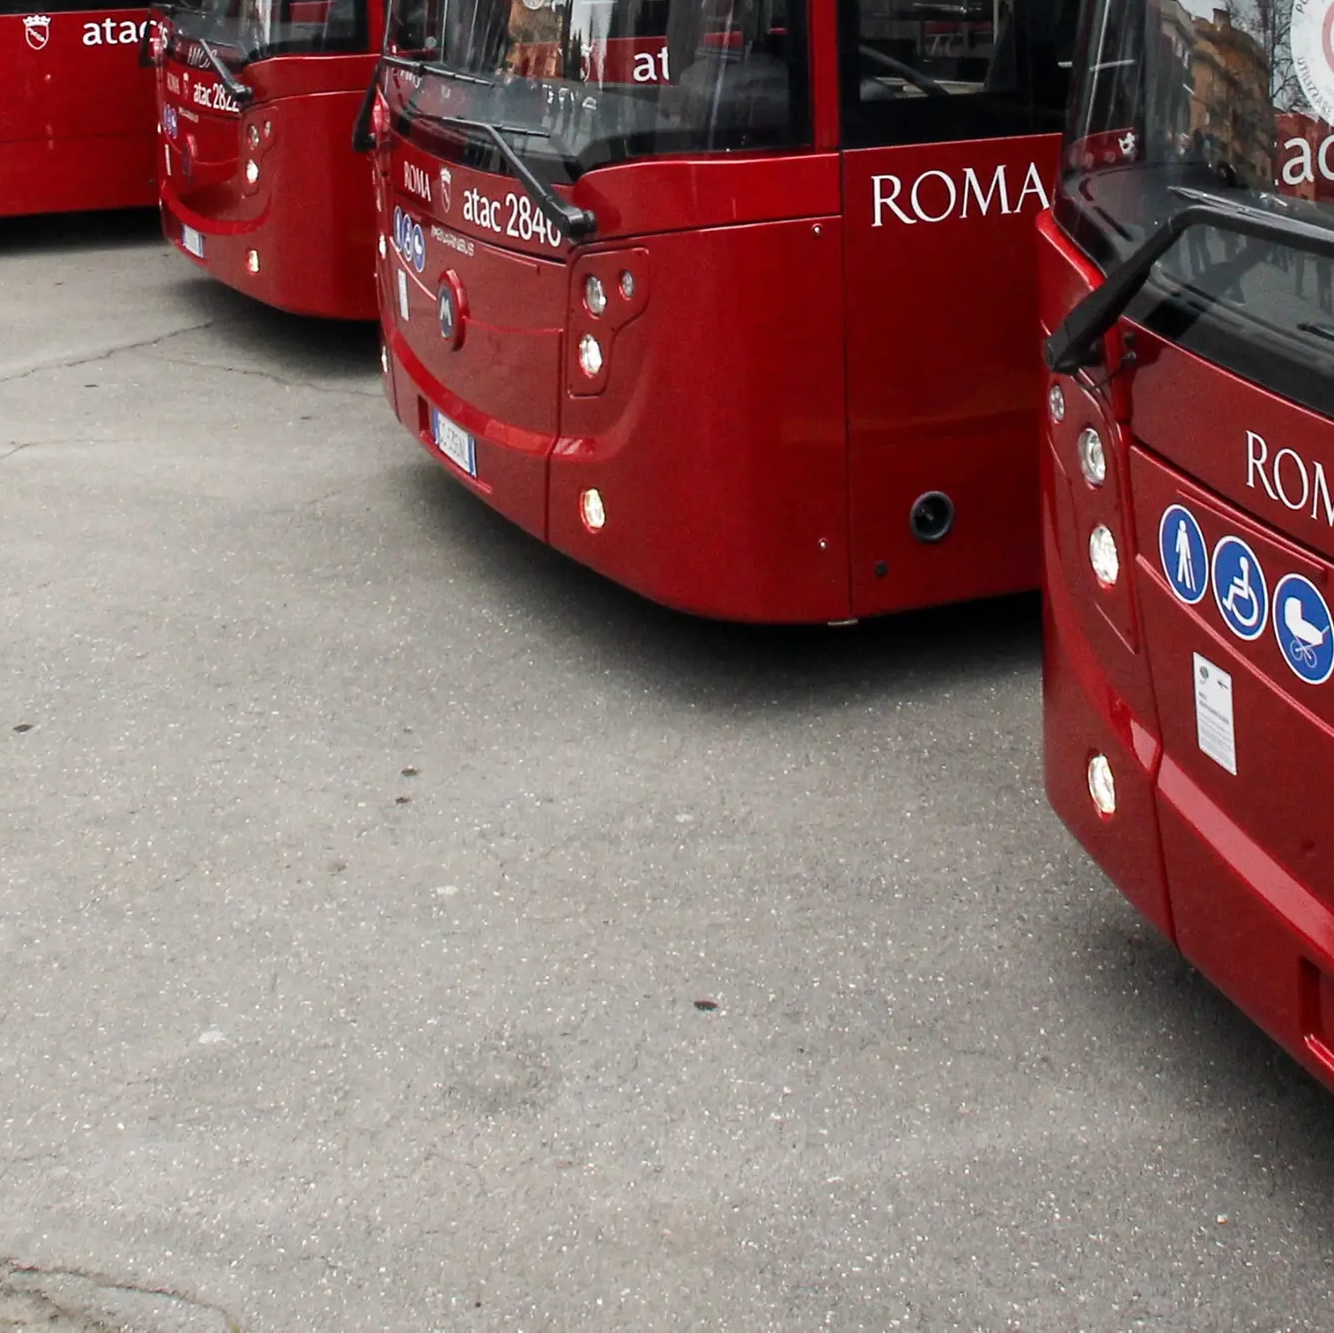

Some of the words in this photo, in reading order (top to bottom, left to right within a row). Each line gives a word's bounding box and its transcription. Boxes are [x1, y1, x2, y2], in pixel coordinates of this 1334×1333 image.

[633, 46, 670, 82] at
[193, 82, 213, 107] atac
[404, 161, 432, 202] ROMA
[463, 187, 502, 233] atac
[871, 162, 1051, 228] ROMA
